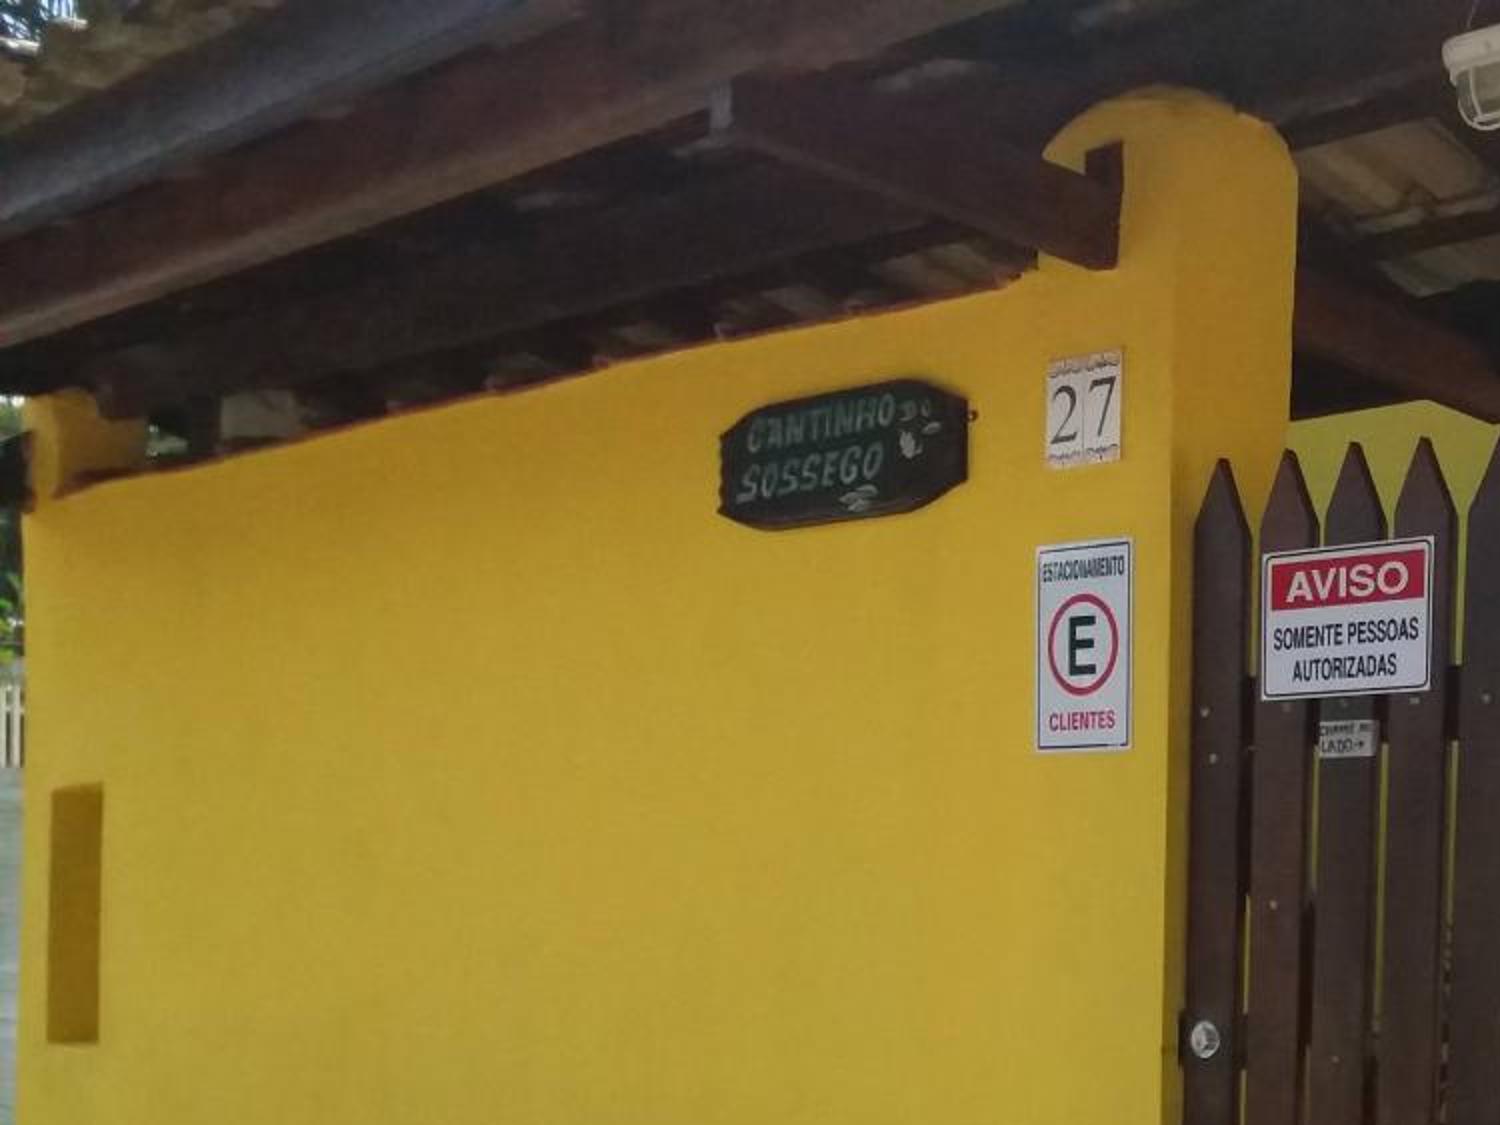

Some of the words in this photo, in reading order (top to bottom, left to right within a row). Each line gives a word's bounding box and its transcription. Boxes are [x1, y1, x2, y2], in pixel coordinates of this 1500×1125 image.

[747, 394, 896, 453] CANTINHO
[1051, 376, 1117, 444] 27
[736, 442, 884, 505] SOSSEGO
[1043, 555, 1125, 583] ESTACIONAMENTO
[1286, 561, 1409, 603] AVISO
[1069, 615, 1096, 676] E
[1273, 623, 1343, 651] SOMENTE
[1347, 616, 1419, 645] PESSOAS
[1292, 653, 1397, 683] AUTORIZADAS
[1050, 710, 1116, 732] CLIENTES
